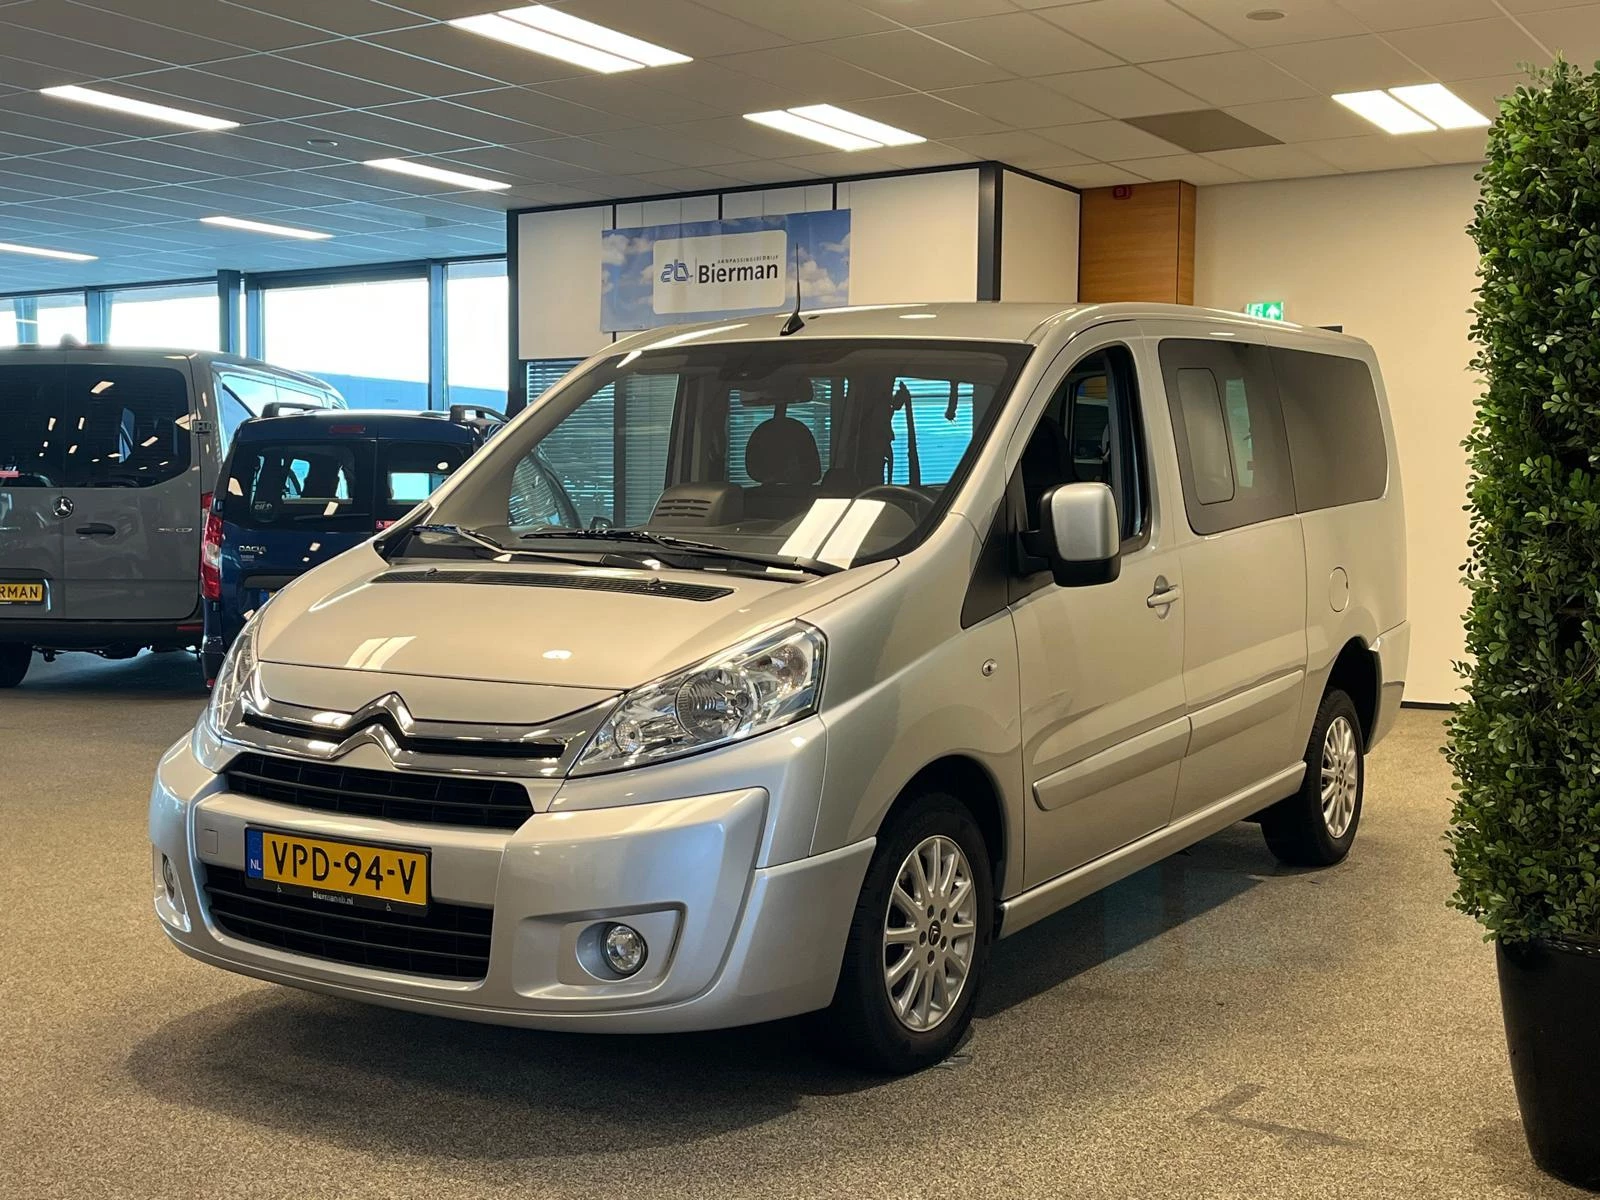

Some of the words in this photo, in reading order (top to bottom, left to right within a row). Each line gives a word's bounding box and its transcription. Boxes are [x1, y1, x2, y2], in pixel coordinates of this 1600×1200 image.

[698, 263, 778, 284] Bierman
[250, 859, 262, 871] NL
[272, 840, 417, 895] VPD-94-V
